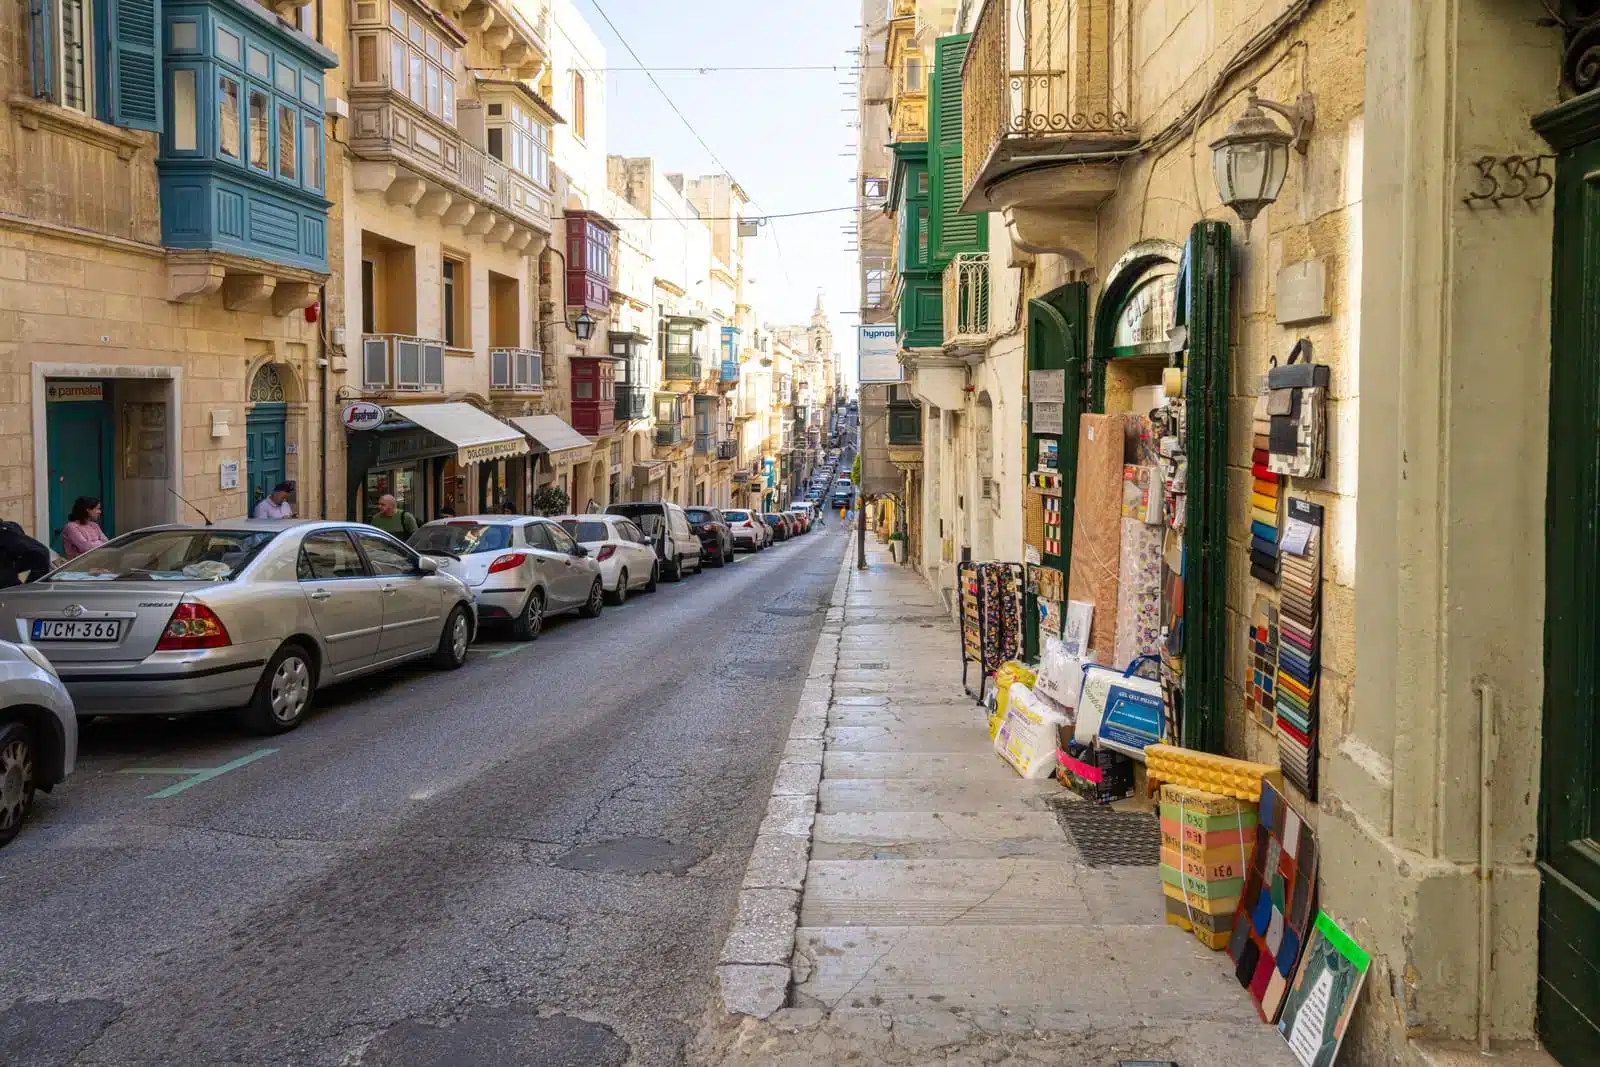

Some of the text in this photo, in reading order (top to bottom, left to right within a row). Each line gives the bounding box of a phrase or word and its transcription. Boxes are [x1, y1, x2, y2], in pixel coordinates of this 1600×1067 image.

[1464, 155, 1557, 202] 335
[863, 329, 896, 339] hypnos
[58, 384, 104, 399] parmalat
[347, 407, 379, 424] Segafredo
[467, 446, 494, 459] DOLCERIA
